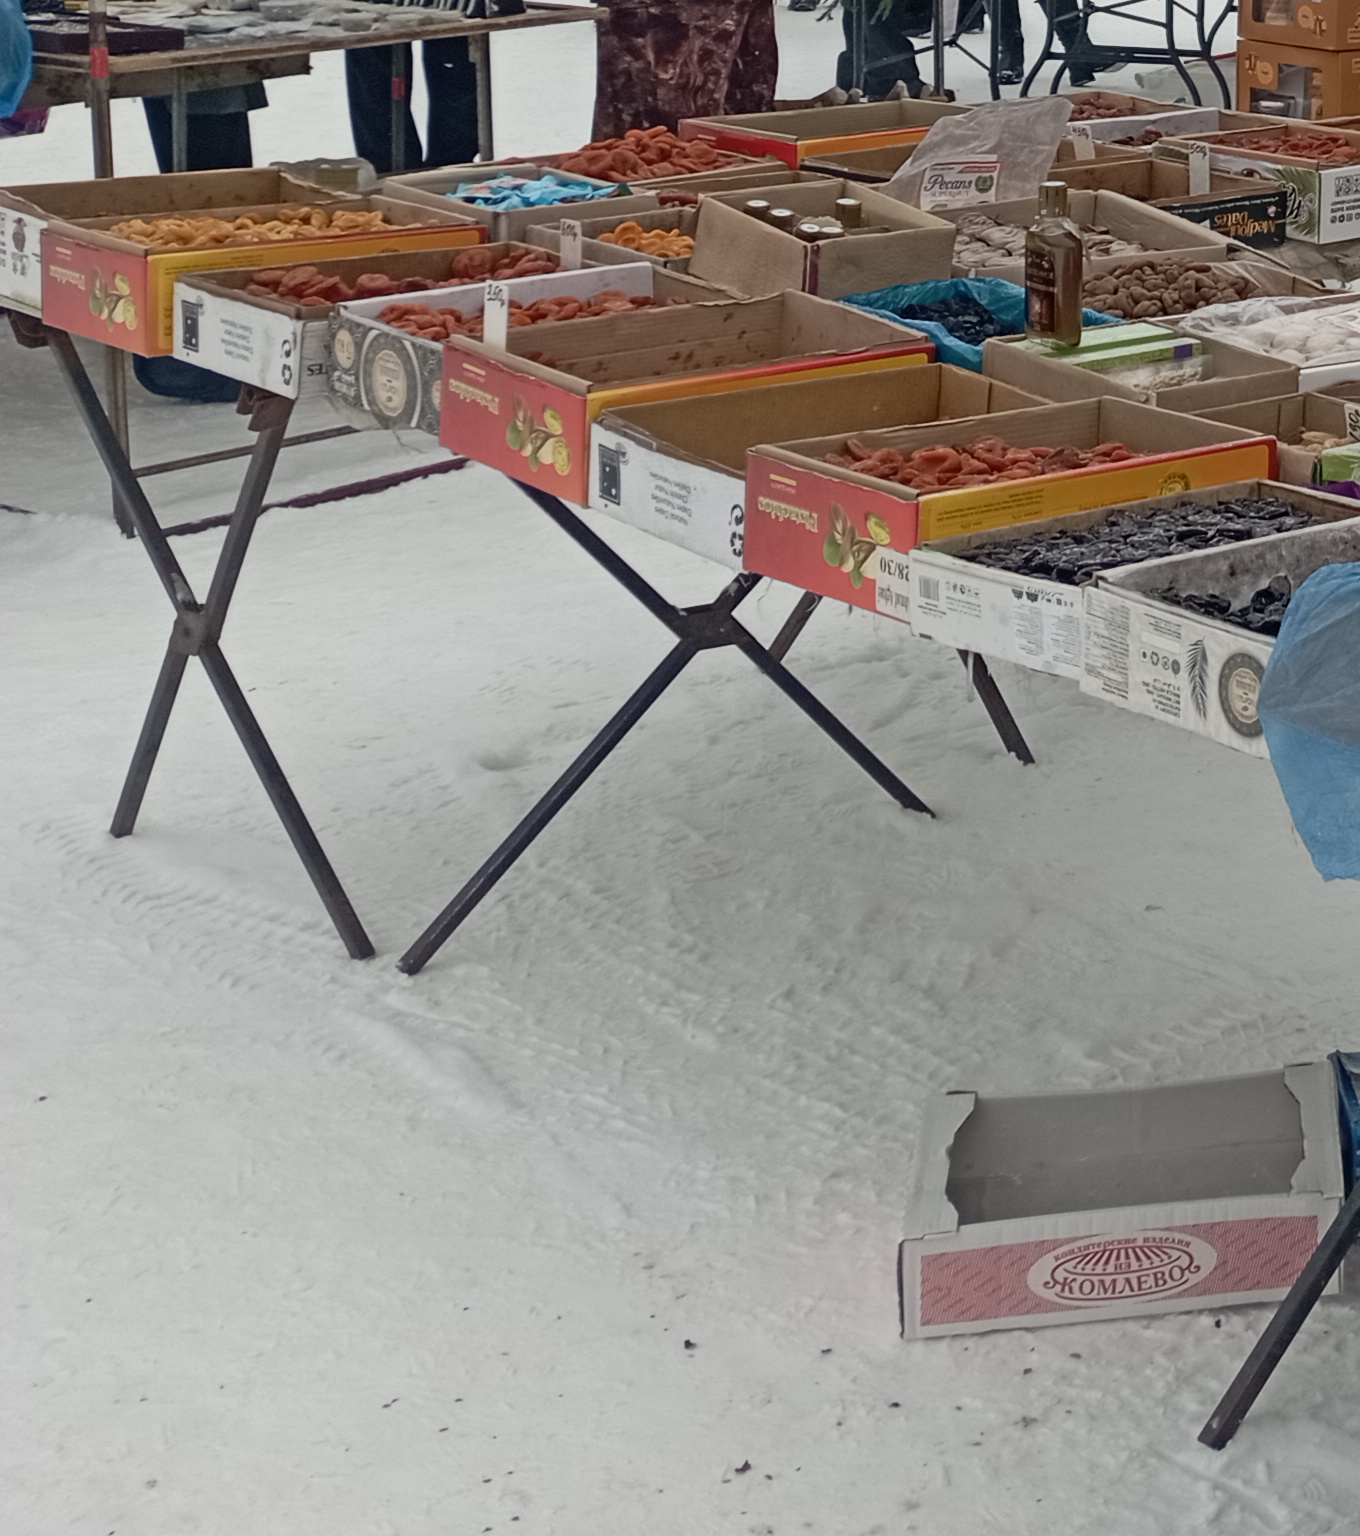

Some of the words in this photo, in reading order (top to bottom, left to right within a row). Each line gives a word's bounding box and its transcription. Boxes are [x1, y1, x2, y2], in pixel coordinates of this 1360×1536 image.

[923, 174, 974, 191] Pecans
[1213, 211, 1249, 227] Dates
[757, 495, 819, 534] Pistachios
[1052, 1236, 1139, 1263] кондитерские
[1142, 1236, 1192, 1249] изделия
[1113, 1262, 1132, 1272] из
[1058, 1264, 1185, 1296] КОМЛЕВО
